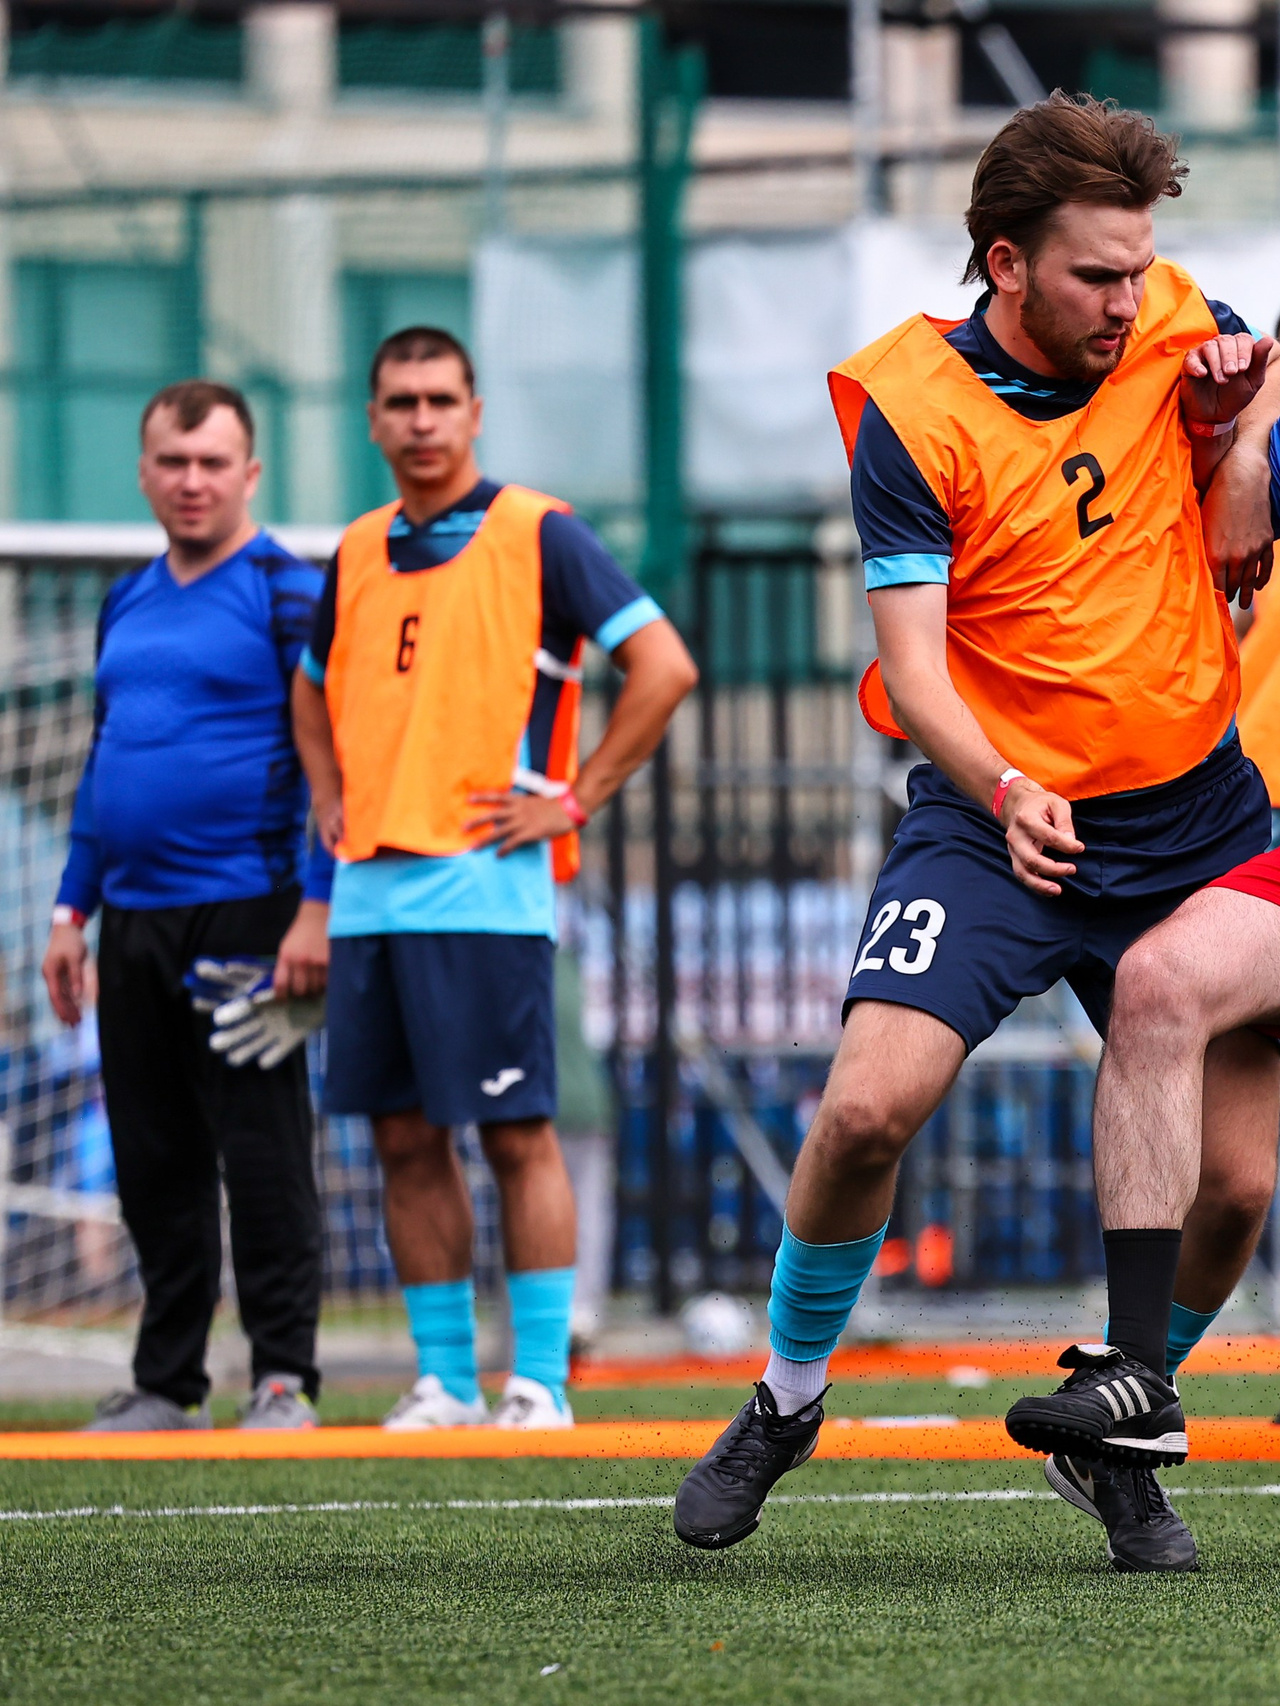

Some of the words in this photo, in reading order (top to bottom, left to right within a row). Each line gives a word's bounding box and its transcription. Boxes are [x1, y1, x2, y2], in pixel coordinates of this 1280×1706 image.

[1061, 452, 1115, 540] 2
[397, 615, 419, 672] 6
[851, 898, 946, 979] 23
